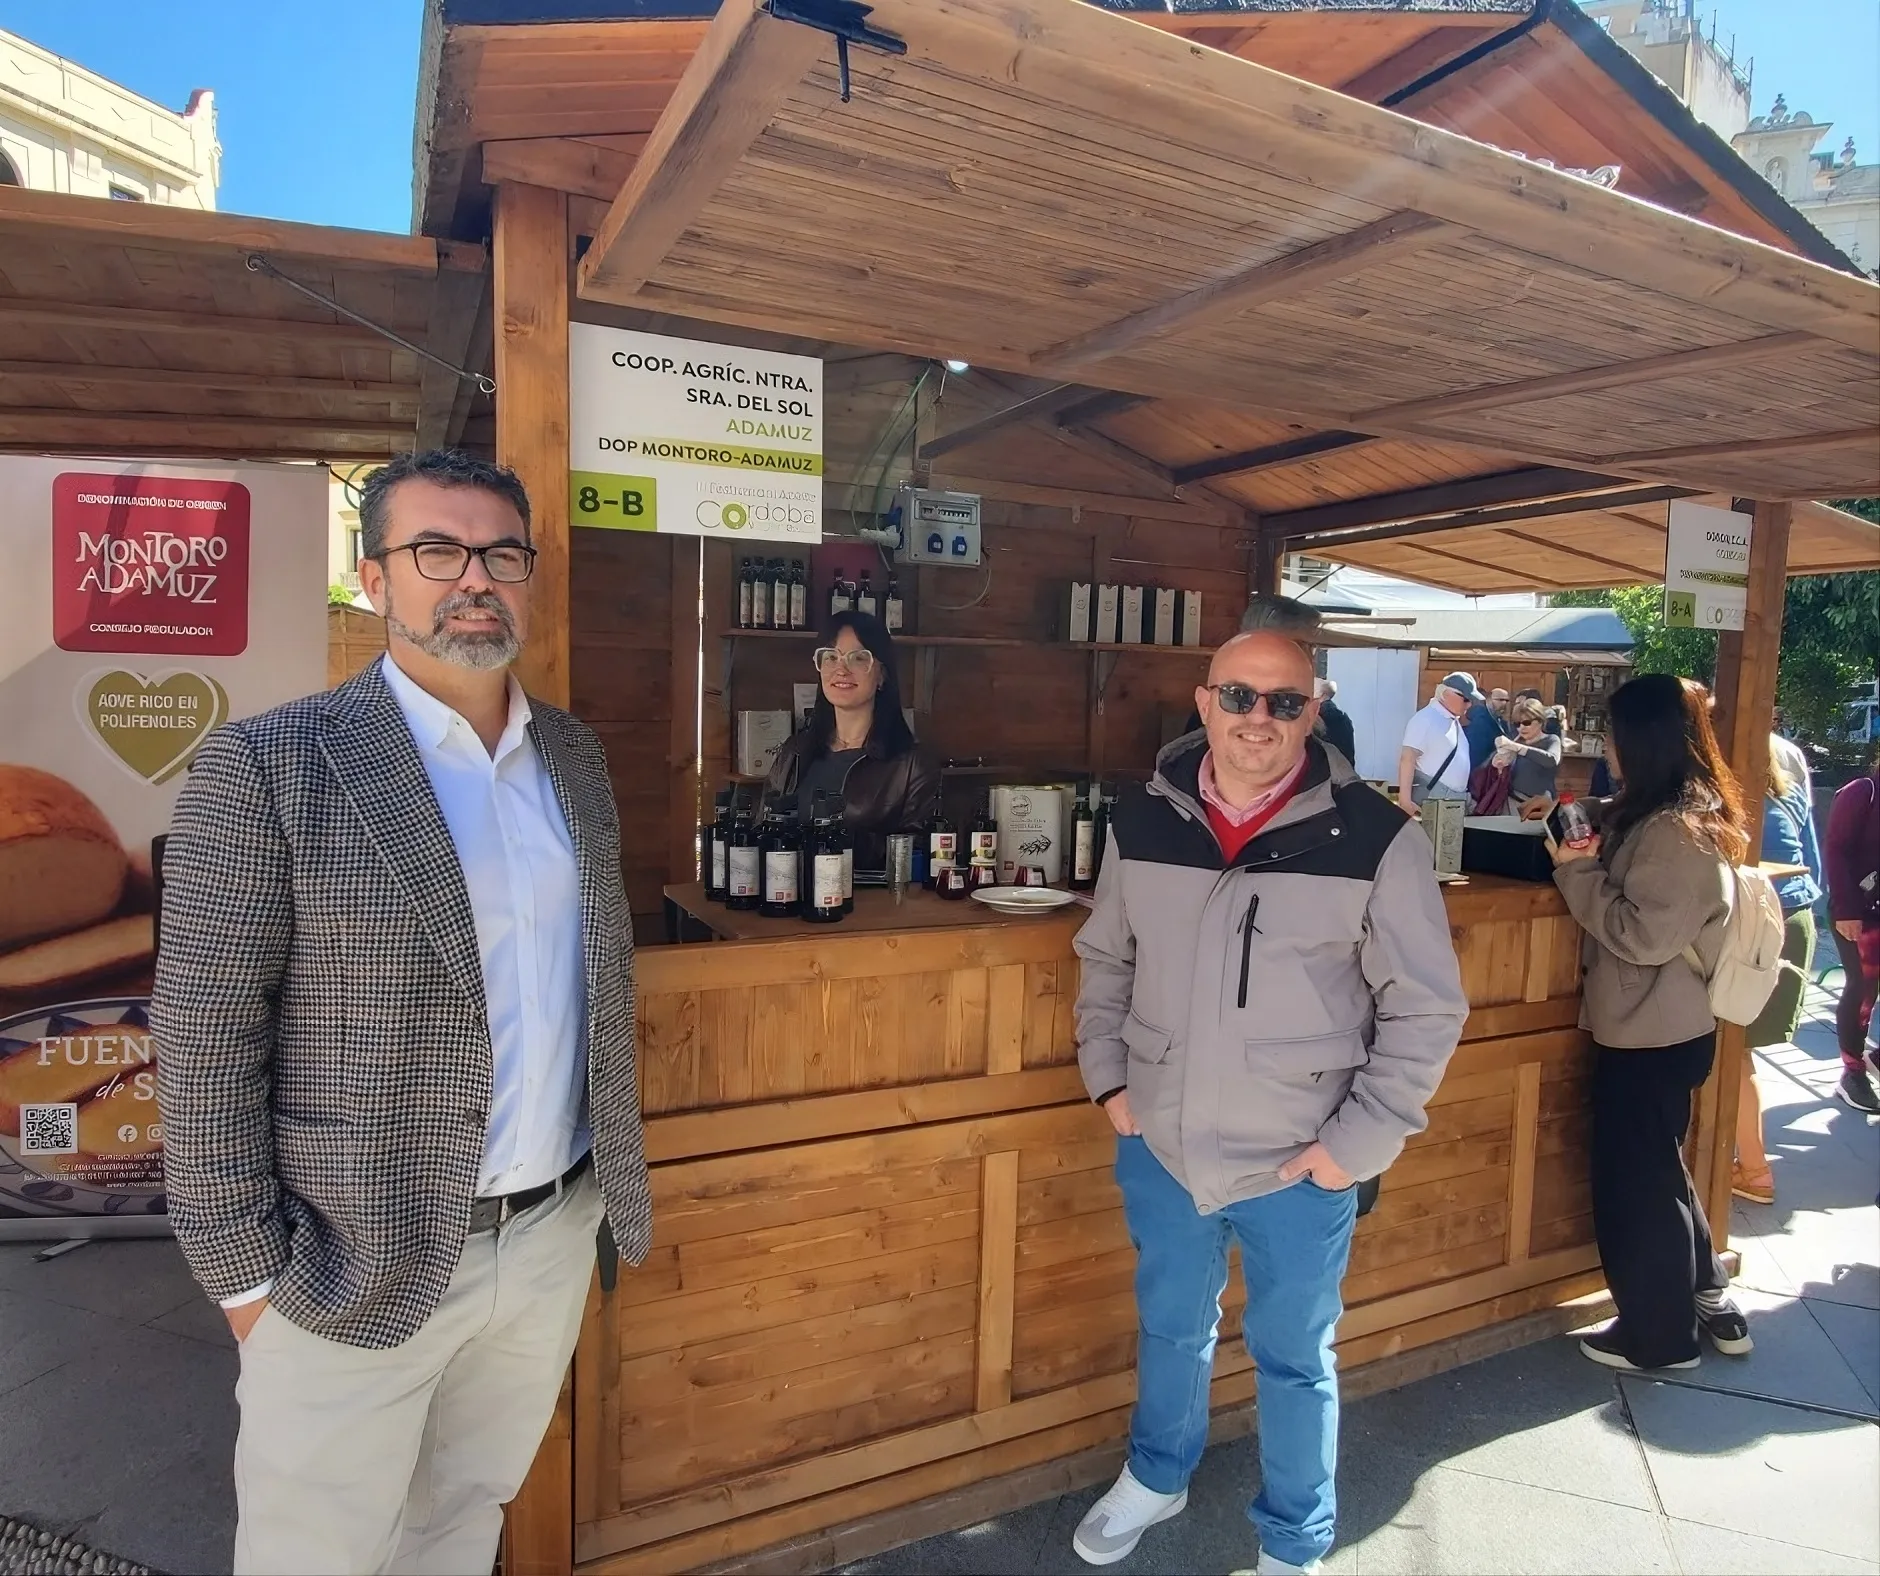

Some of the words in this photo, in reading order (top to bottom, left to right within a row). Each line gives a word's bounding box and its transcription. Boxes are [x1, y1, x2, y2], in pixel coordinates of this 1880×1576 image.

[611, 351, 678, 375] COOP.
[682, 362, 751, 385] AGRÍC.
[755, 370, 813, 393] NTRA.
[686, 388, 732, 408] SRA.
[738, 394, 773, 412] DEL
[778, 400, 813, 418] SOL
[726, 418, 813, 442] ADAMUZ
[598, 437, 638, 453] DOP
[642, 441, 813, 472] MONTORO-ADAMUZ
[578, 486, 644, 517] 8-B
[75, 531, 228, 571] MONTORO
[76, 562, 218, 604] ADAMUZ
[98, 693, 136, 708] AOVE
[139, 694, 173, 709] RICO
[178, 695, 198, 710] EN
[100, 713, 197, 729] POLIFENOLES
[37, 1035, 154, 1066] FUEN
[95, 1072, 125, 1100] de
[133, 1072, 156, 1101] S
